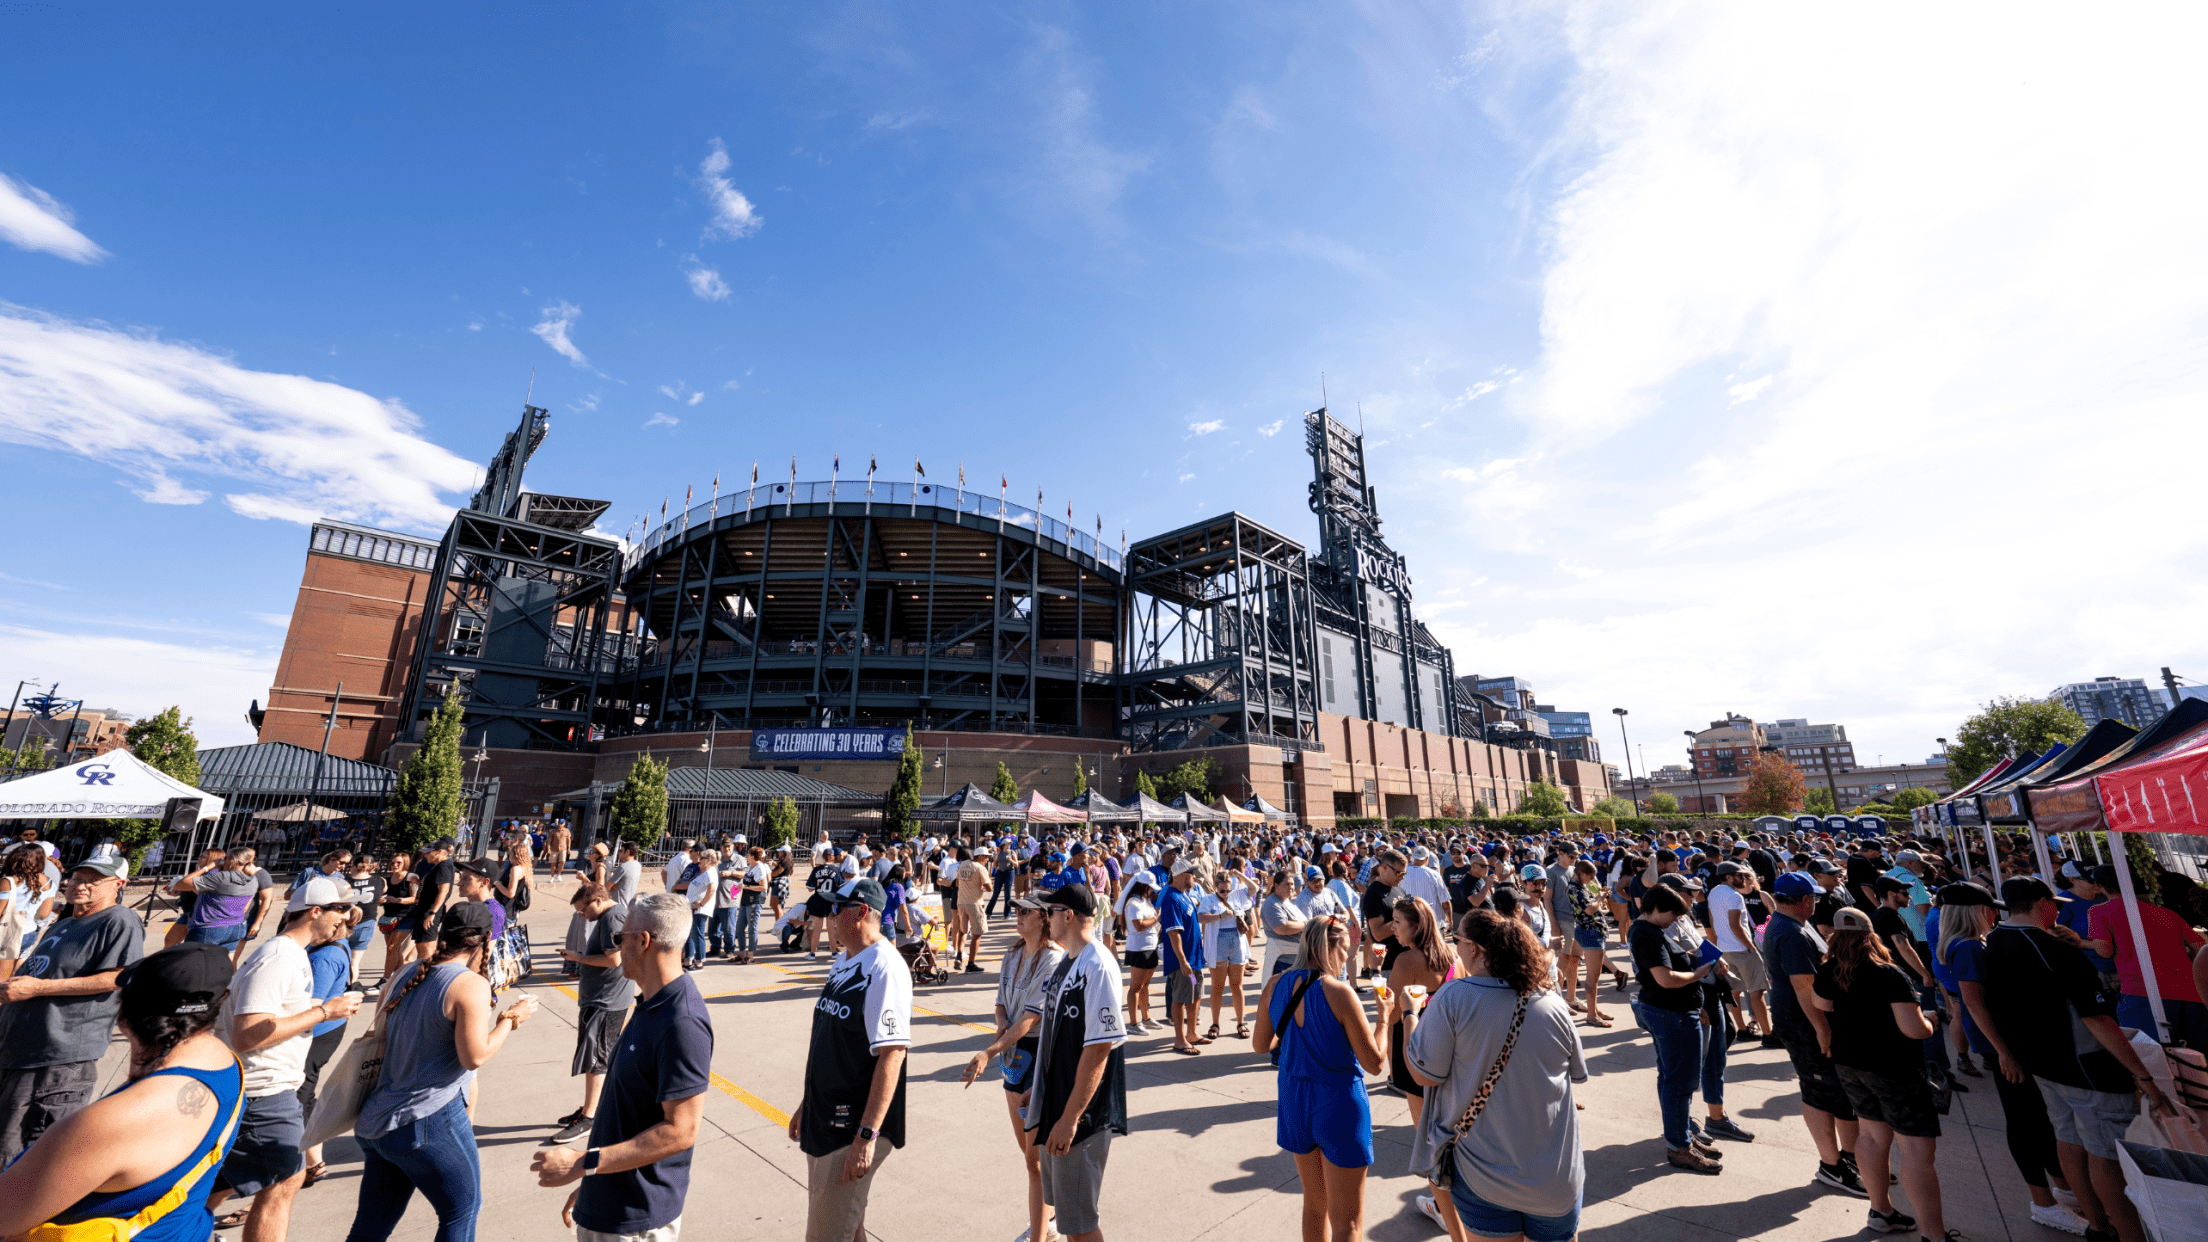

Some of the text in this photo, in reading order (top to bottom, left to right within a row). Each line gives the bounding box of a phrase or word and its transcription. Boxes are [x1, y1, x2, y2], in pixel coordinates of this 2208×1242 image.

[1355, 546, 1413, 603] ROCKIES
[773, 733, 835, 753] CELEBRATING
[837, 733, 850, 752] 30
[853, 734, 884, 753] YEARS
[892, 738, 903, 747] 30
[0, 802, 161, 815] OLORADO ROCKIES
[910, 811, 959, 820] COLORADO ROCKIES
[960, 812, 999, 820] COLORADO
